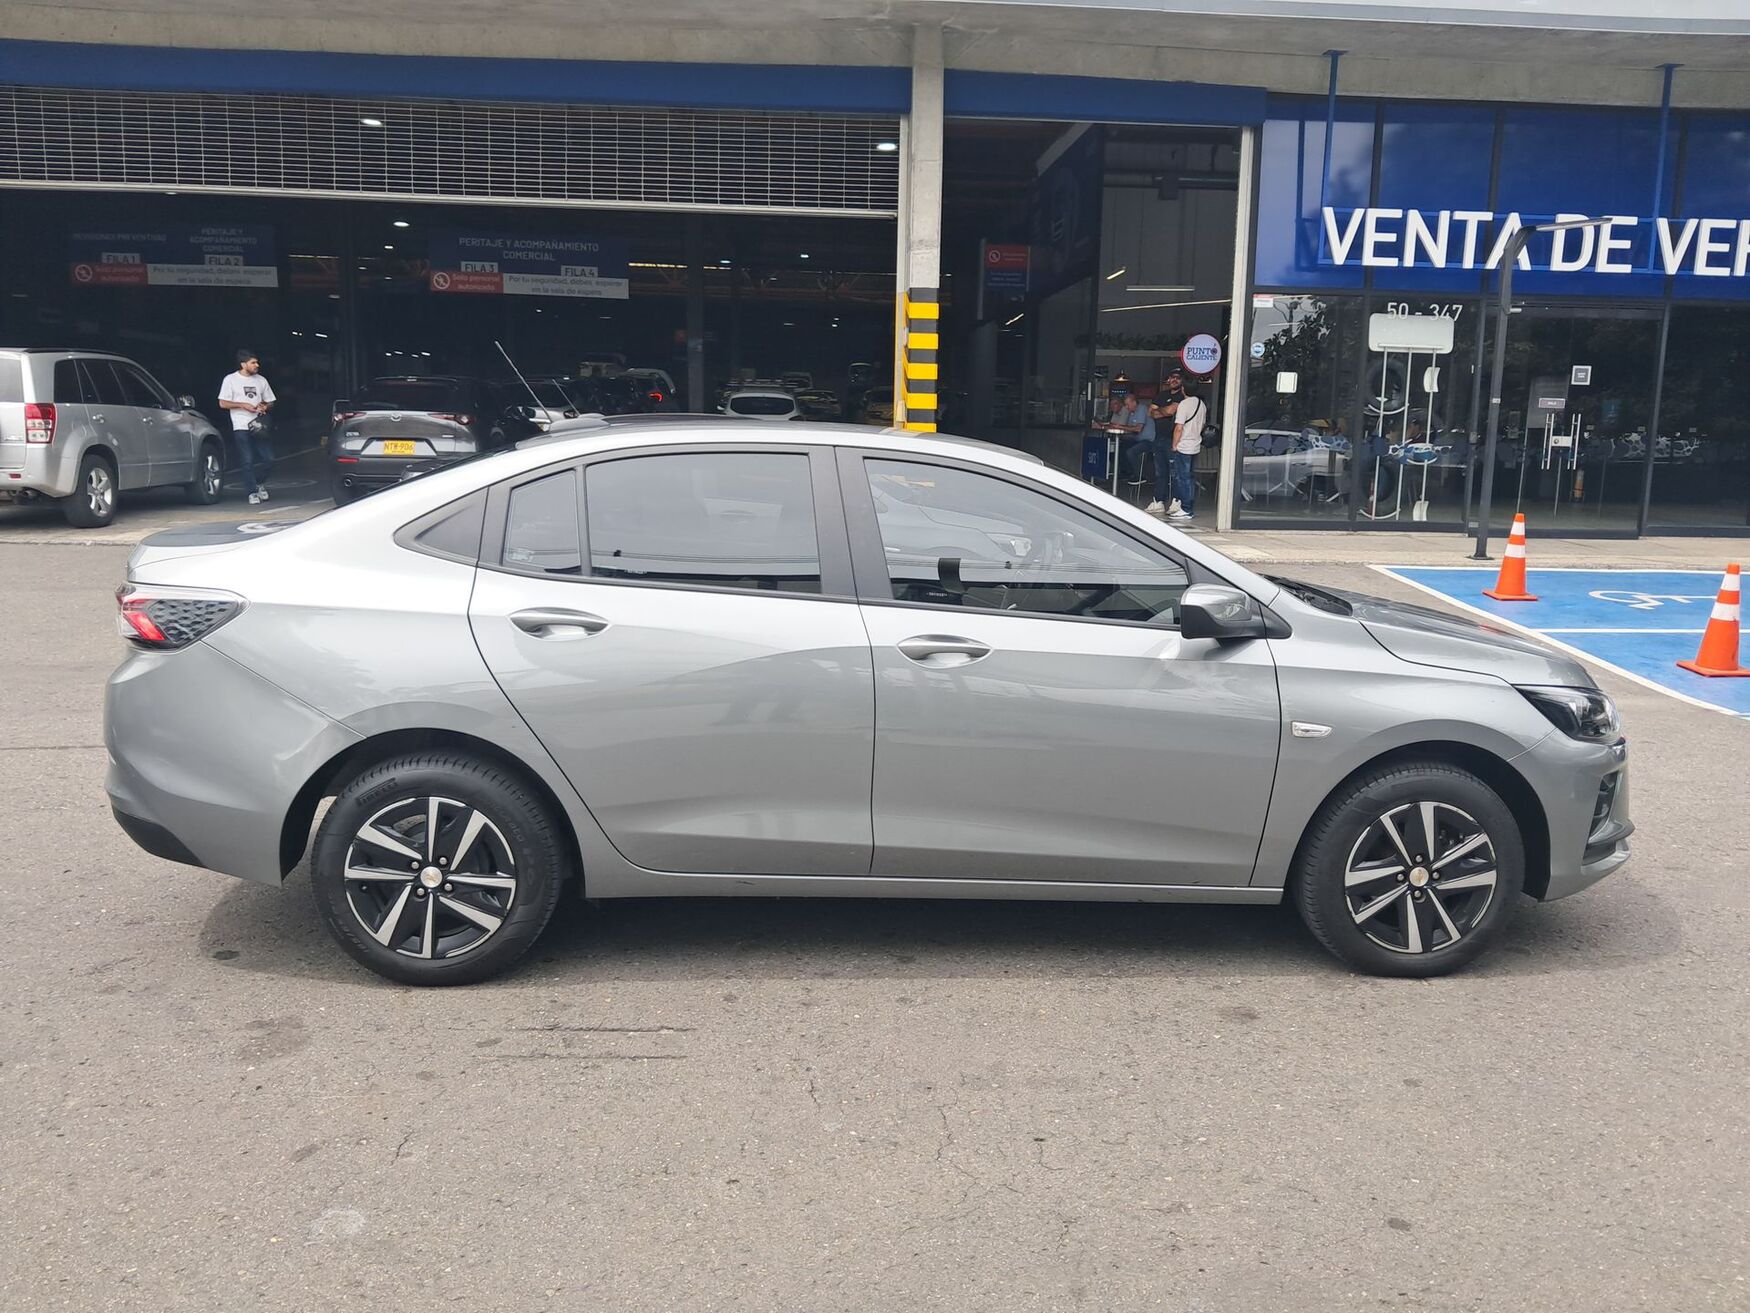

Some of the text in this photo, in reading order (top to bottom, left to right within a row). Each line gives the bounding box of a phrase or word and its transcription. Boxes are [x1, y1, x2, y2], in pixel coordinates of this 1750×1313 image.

[459, 237, 599, 252] PERITAJE Y ACOMPAÑAMIENTO
[1321, 206, 1532, 271] VENTA
[1550, 213, 1639, 273] DE
[106, 254, 131, 264] FILA
[503, 250, 555, 261] COMERCIAL
[208, 257, 240, 267] FILA 2
[465, 263, 496, 273] FILA 3
[565, 267, 596, 277] FILA 4
[508, 275, 520, 283] Por
[1386, 303, 1409, 320] 50
[1429, 303, 1463, 321] 347
[1187, 347, 1217, 355] PUNTO
